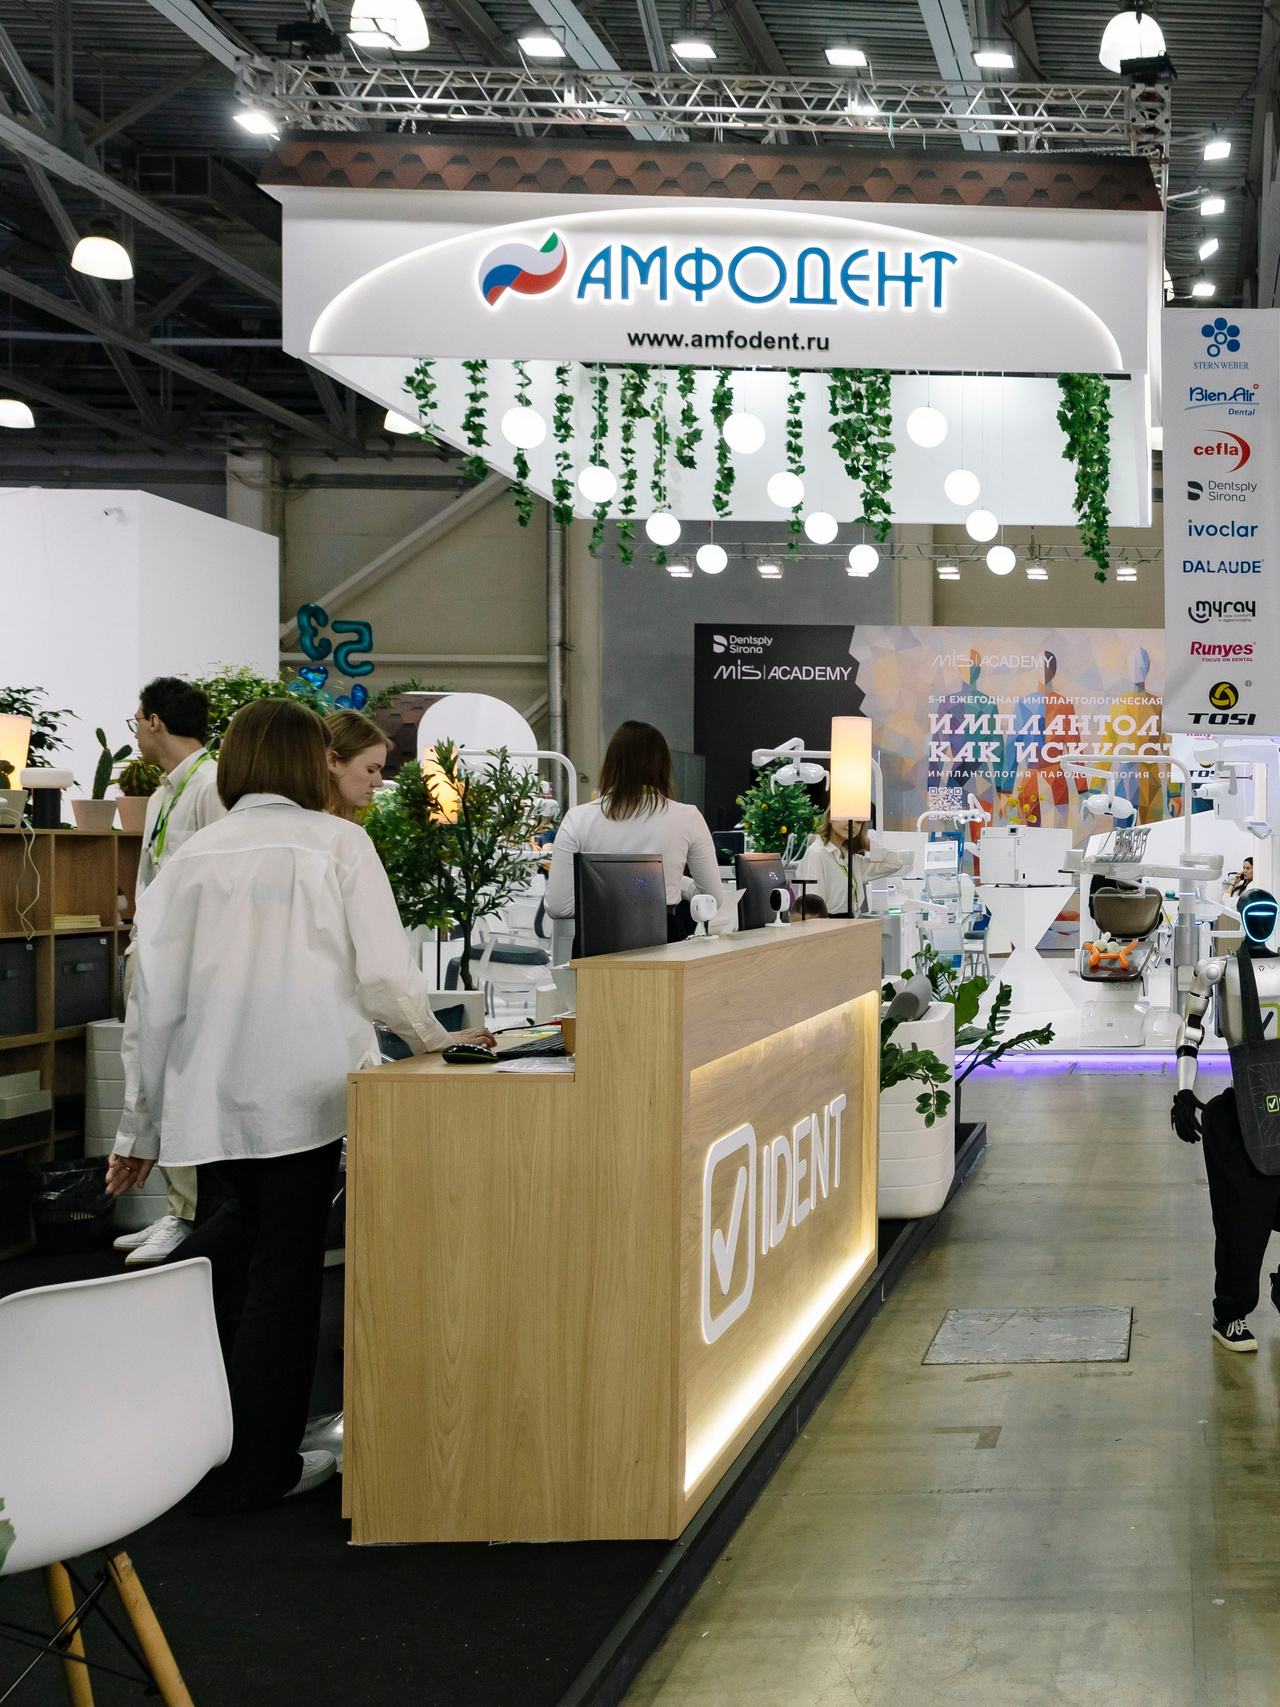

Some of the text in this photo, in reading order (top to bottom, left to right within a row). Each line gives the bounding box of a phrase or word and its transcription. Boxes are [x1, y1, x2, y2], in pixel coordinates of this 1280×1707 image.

[577, 243, 958, 309] АМФОДЕНТ
[627, 329, 830, 351] www.amfodent.ru
[1220, 362, 1249, 370] WEBER
[1228, 408, 1255, 416] Dental
[1193, 443, 1238, 455] cefla
[1208, 480, 1257, 492] Dentsply
[1208, 492, 1246, 502] Sirona
[1188, 519, 1258, 537] ivoclar
[1182, 560, 1261, 574] DALAUDE
[1196, 600, 1256, 617] myray
[729, 635, 773, 646] Dentsply
[729, 645, 763, 654] Sirona
[1190, 641, 1254, 658] Runyes
[979, 655, 1053, 668] ACADEMY
[767, 665, 852, 680] ACADEMY
[928, 695, 1163, 705] 5-Я ЕЖЕГОДНАЯ ИМПЛАНТОЛОГИЧЕСКАЯ
[1188, 713, 1256, 726] TOSI
[928, 741, 1001, 763] КАК
[928, 770, 1031, 778] ИМПЛАНТОЛОГИЯ
[762, 1093, 847, 1255] IDENT
